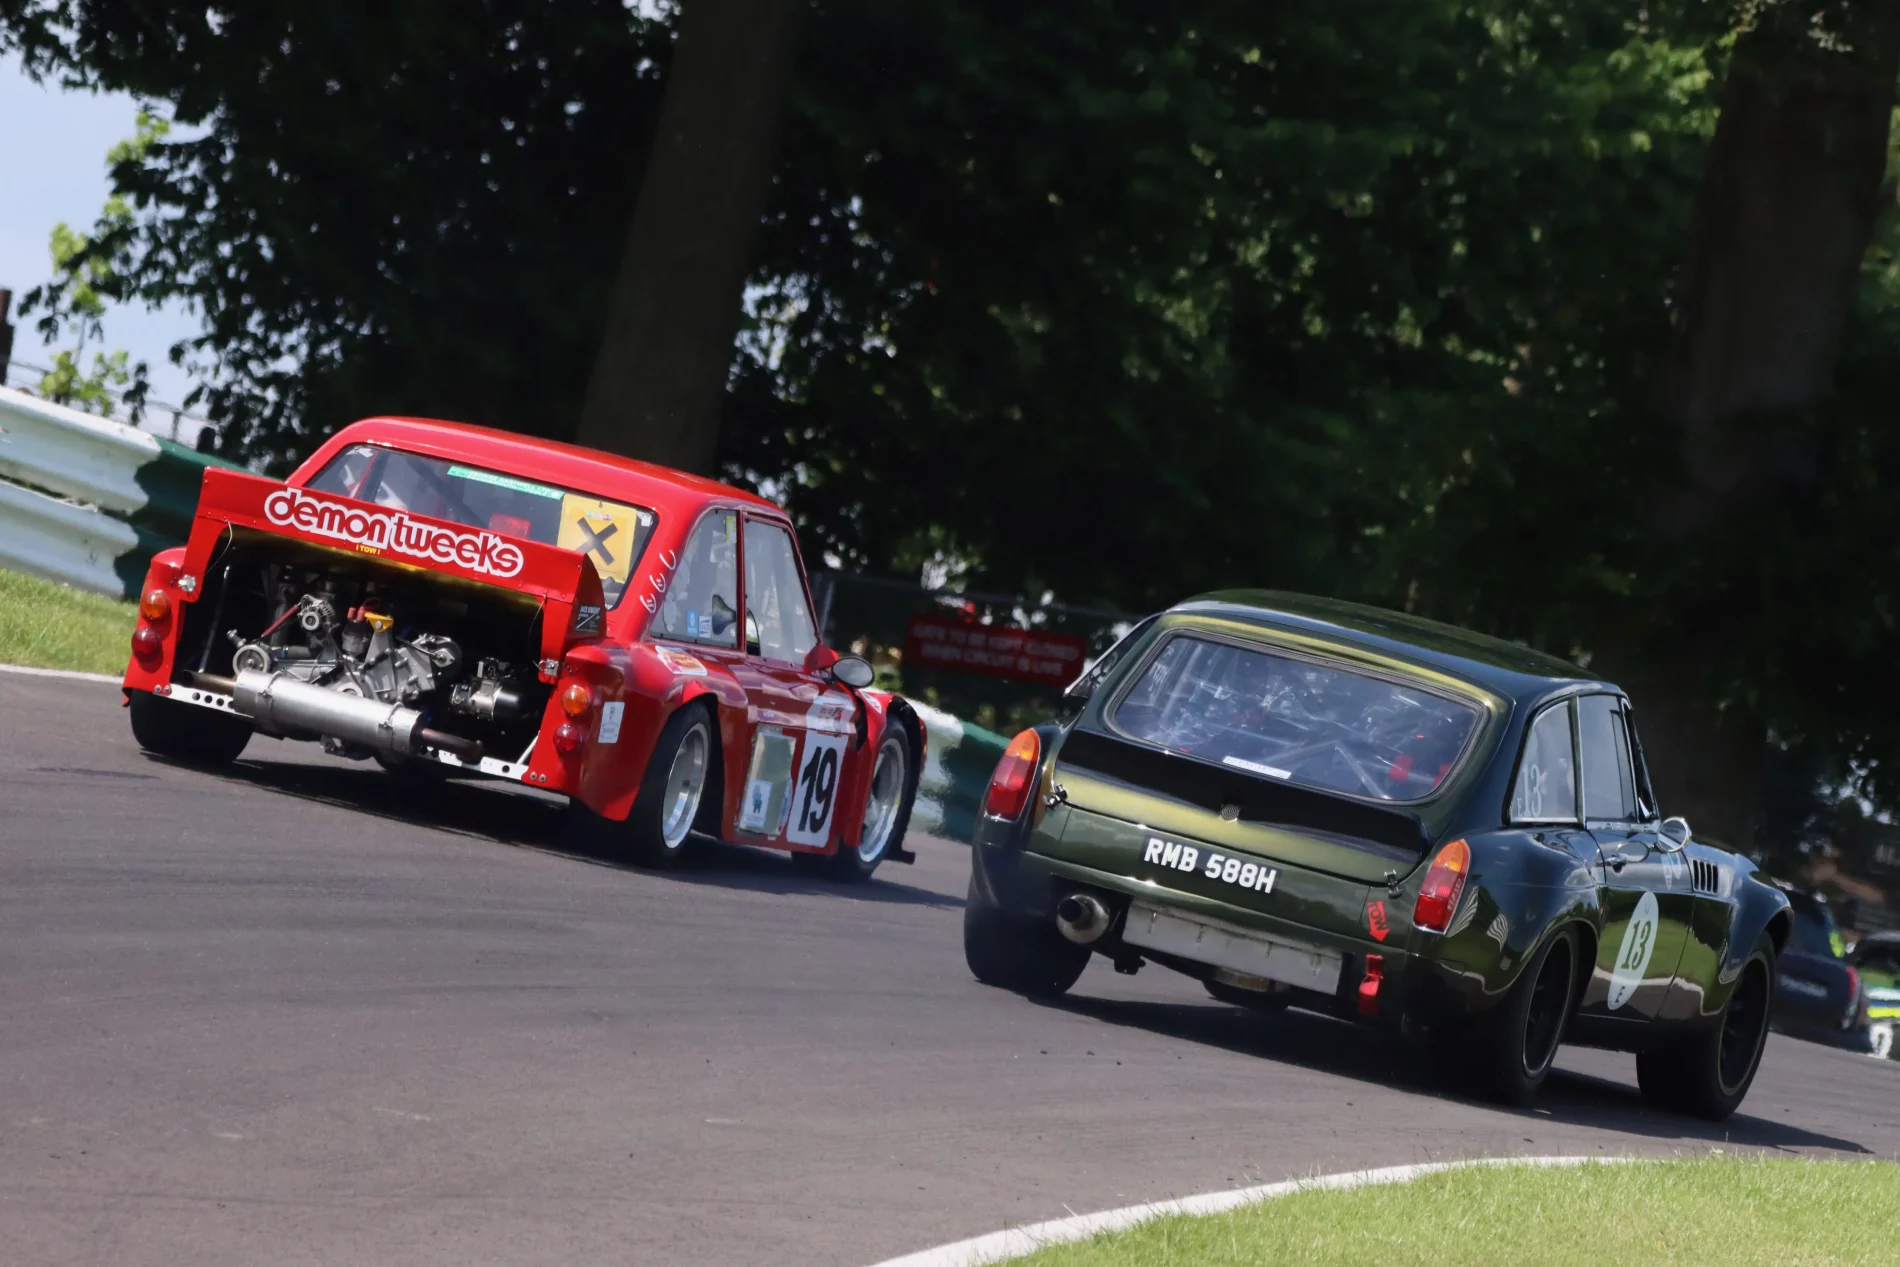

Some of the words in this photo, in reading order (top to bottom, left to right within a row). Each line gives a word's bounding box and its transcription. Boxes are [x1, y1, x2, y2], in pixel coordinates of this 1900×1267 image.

[264, 487, 388, 551] demon
[389, 513, 524, 578] tweeks
[798, 746, 837, 833] 19
[1522, 764, 1542, 818] 13
[1143, 838, 1199, 873] RMB
[1204, 853, 1277, 894] 588H
[1621, 920, 1652, 971] 13
